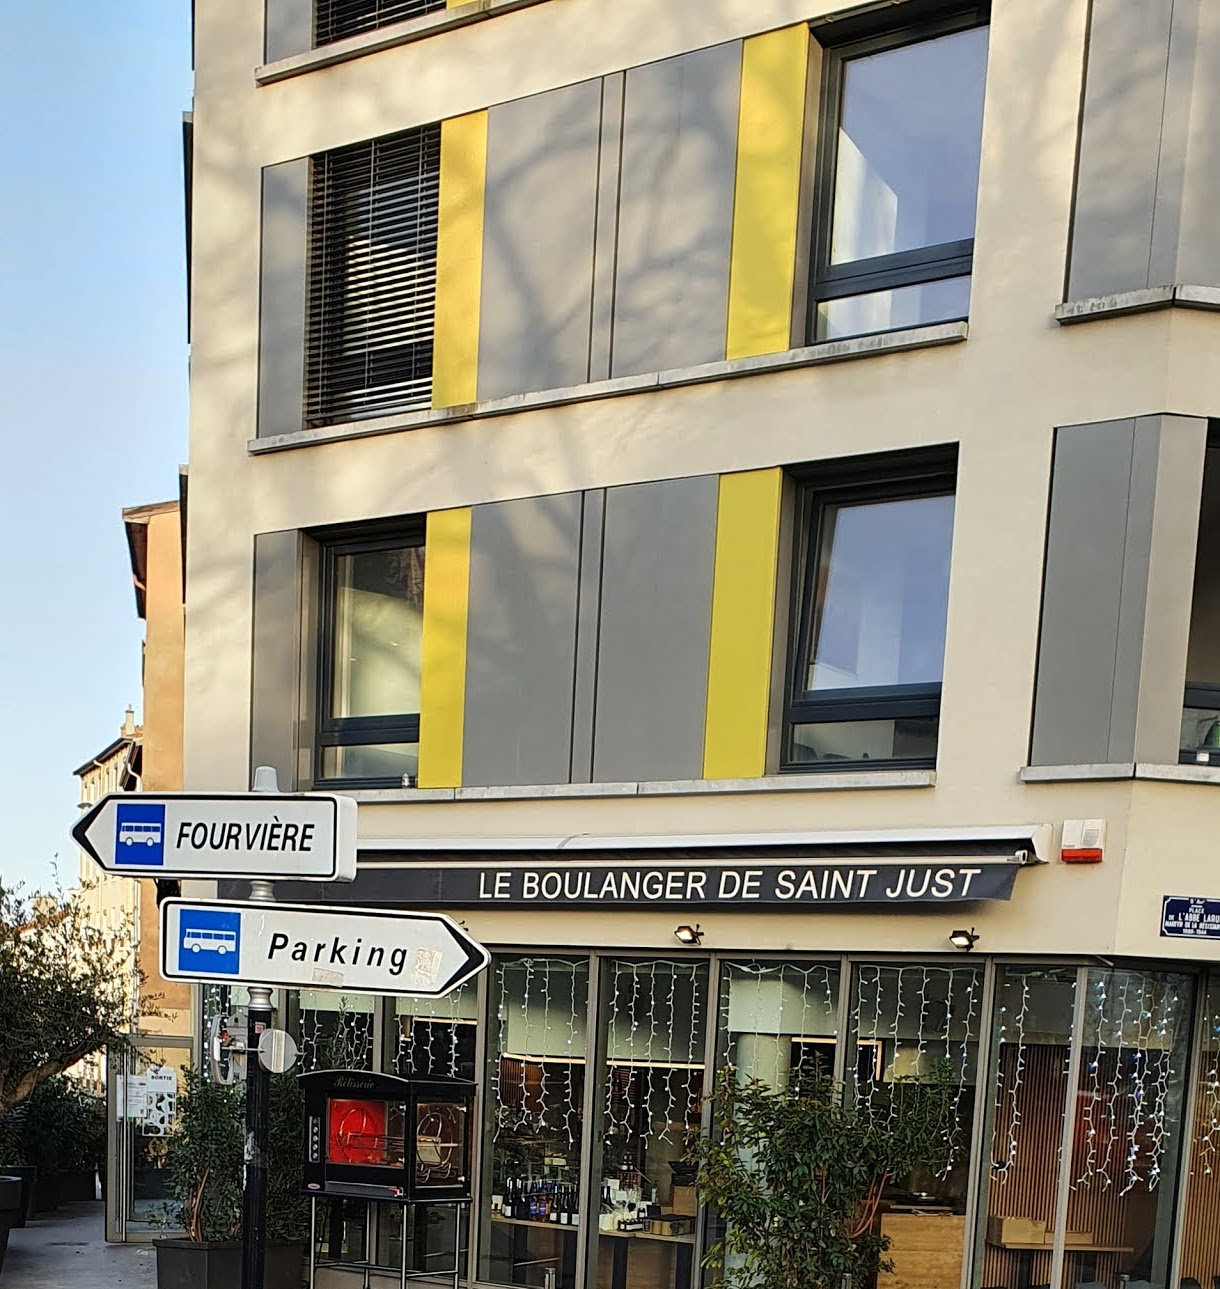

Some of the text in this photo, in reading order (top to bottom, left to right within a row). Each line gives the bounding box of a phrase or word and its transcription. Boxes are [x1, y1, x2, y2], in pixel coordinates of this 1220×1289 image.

[176, 816, 316, 852] FOURVIÈRE
[479, 868, 982, 900] LE BOULANGER DE SAINT JUST
[267, 932, 408, 976] Parking
